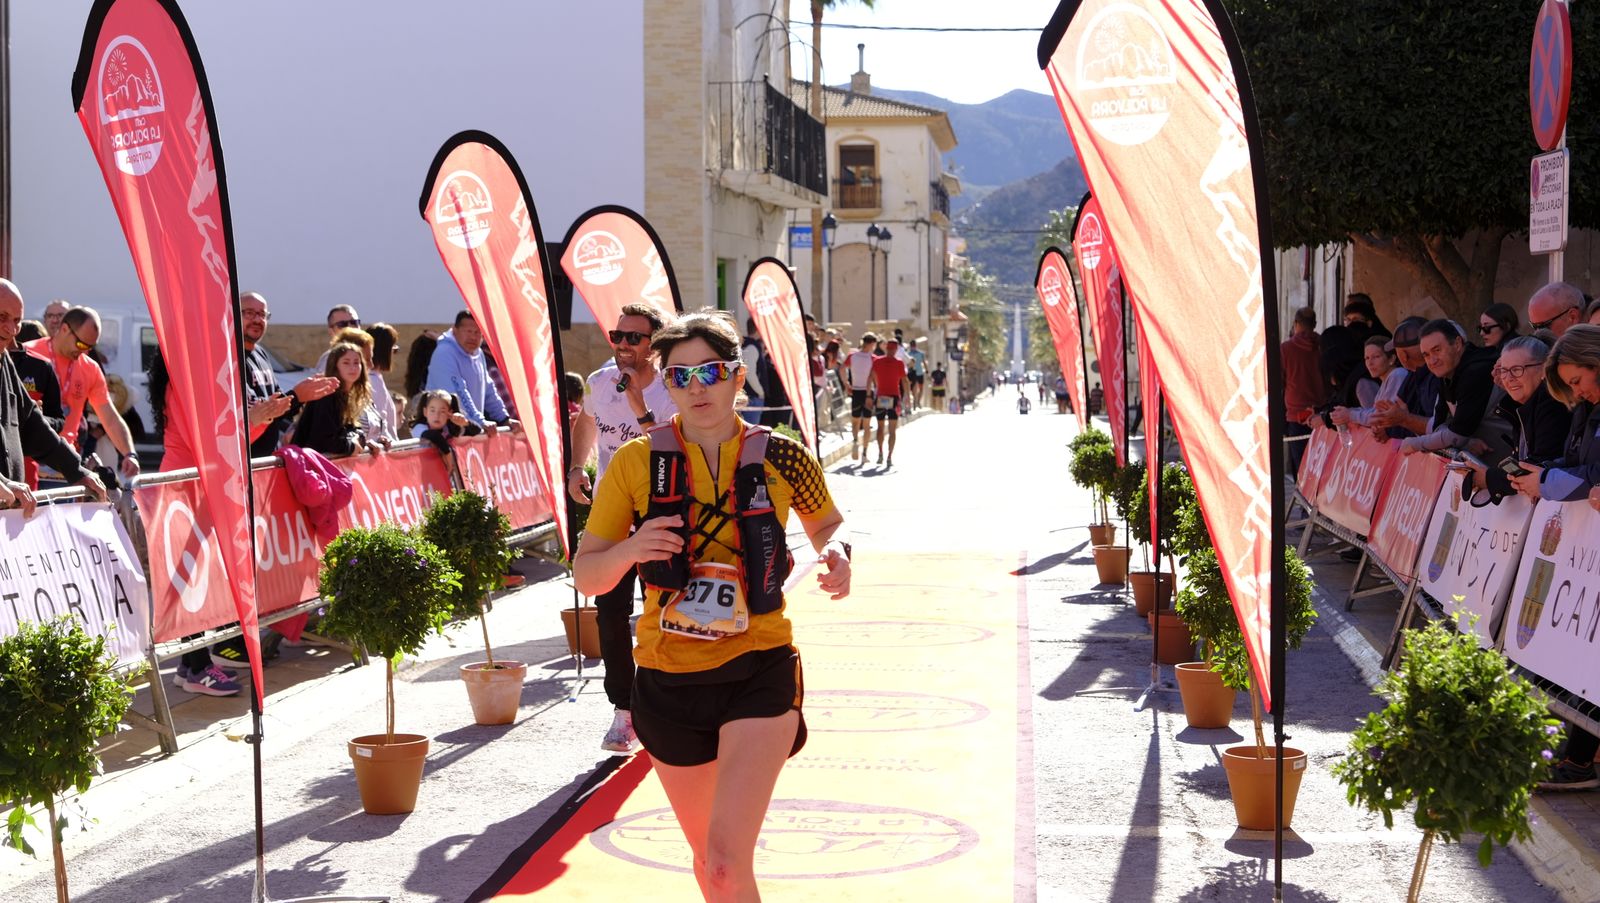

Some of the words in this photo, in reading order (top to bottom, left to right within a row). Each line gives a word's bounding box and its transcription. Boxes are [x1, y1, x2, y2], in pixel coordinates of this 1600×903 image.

[487, 460, 541, 503] VEOLIA
[90, 542, 119, 566] DE
[683, 580, 736, 608] 376
